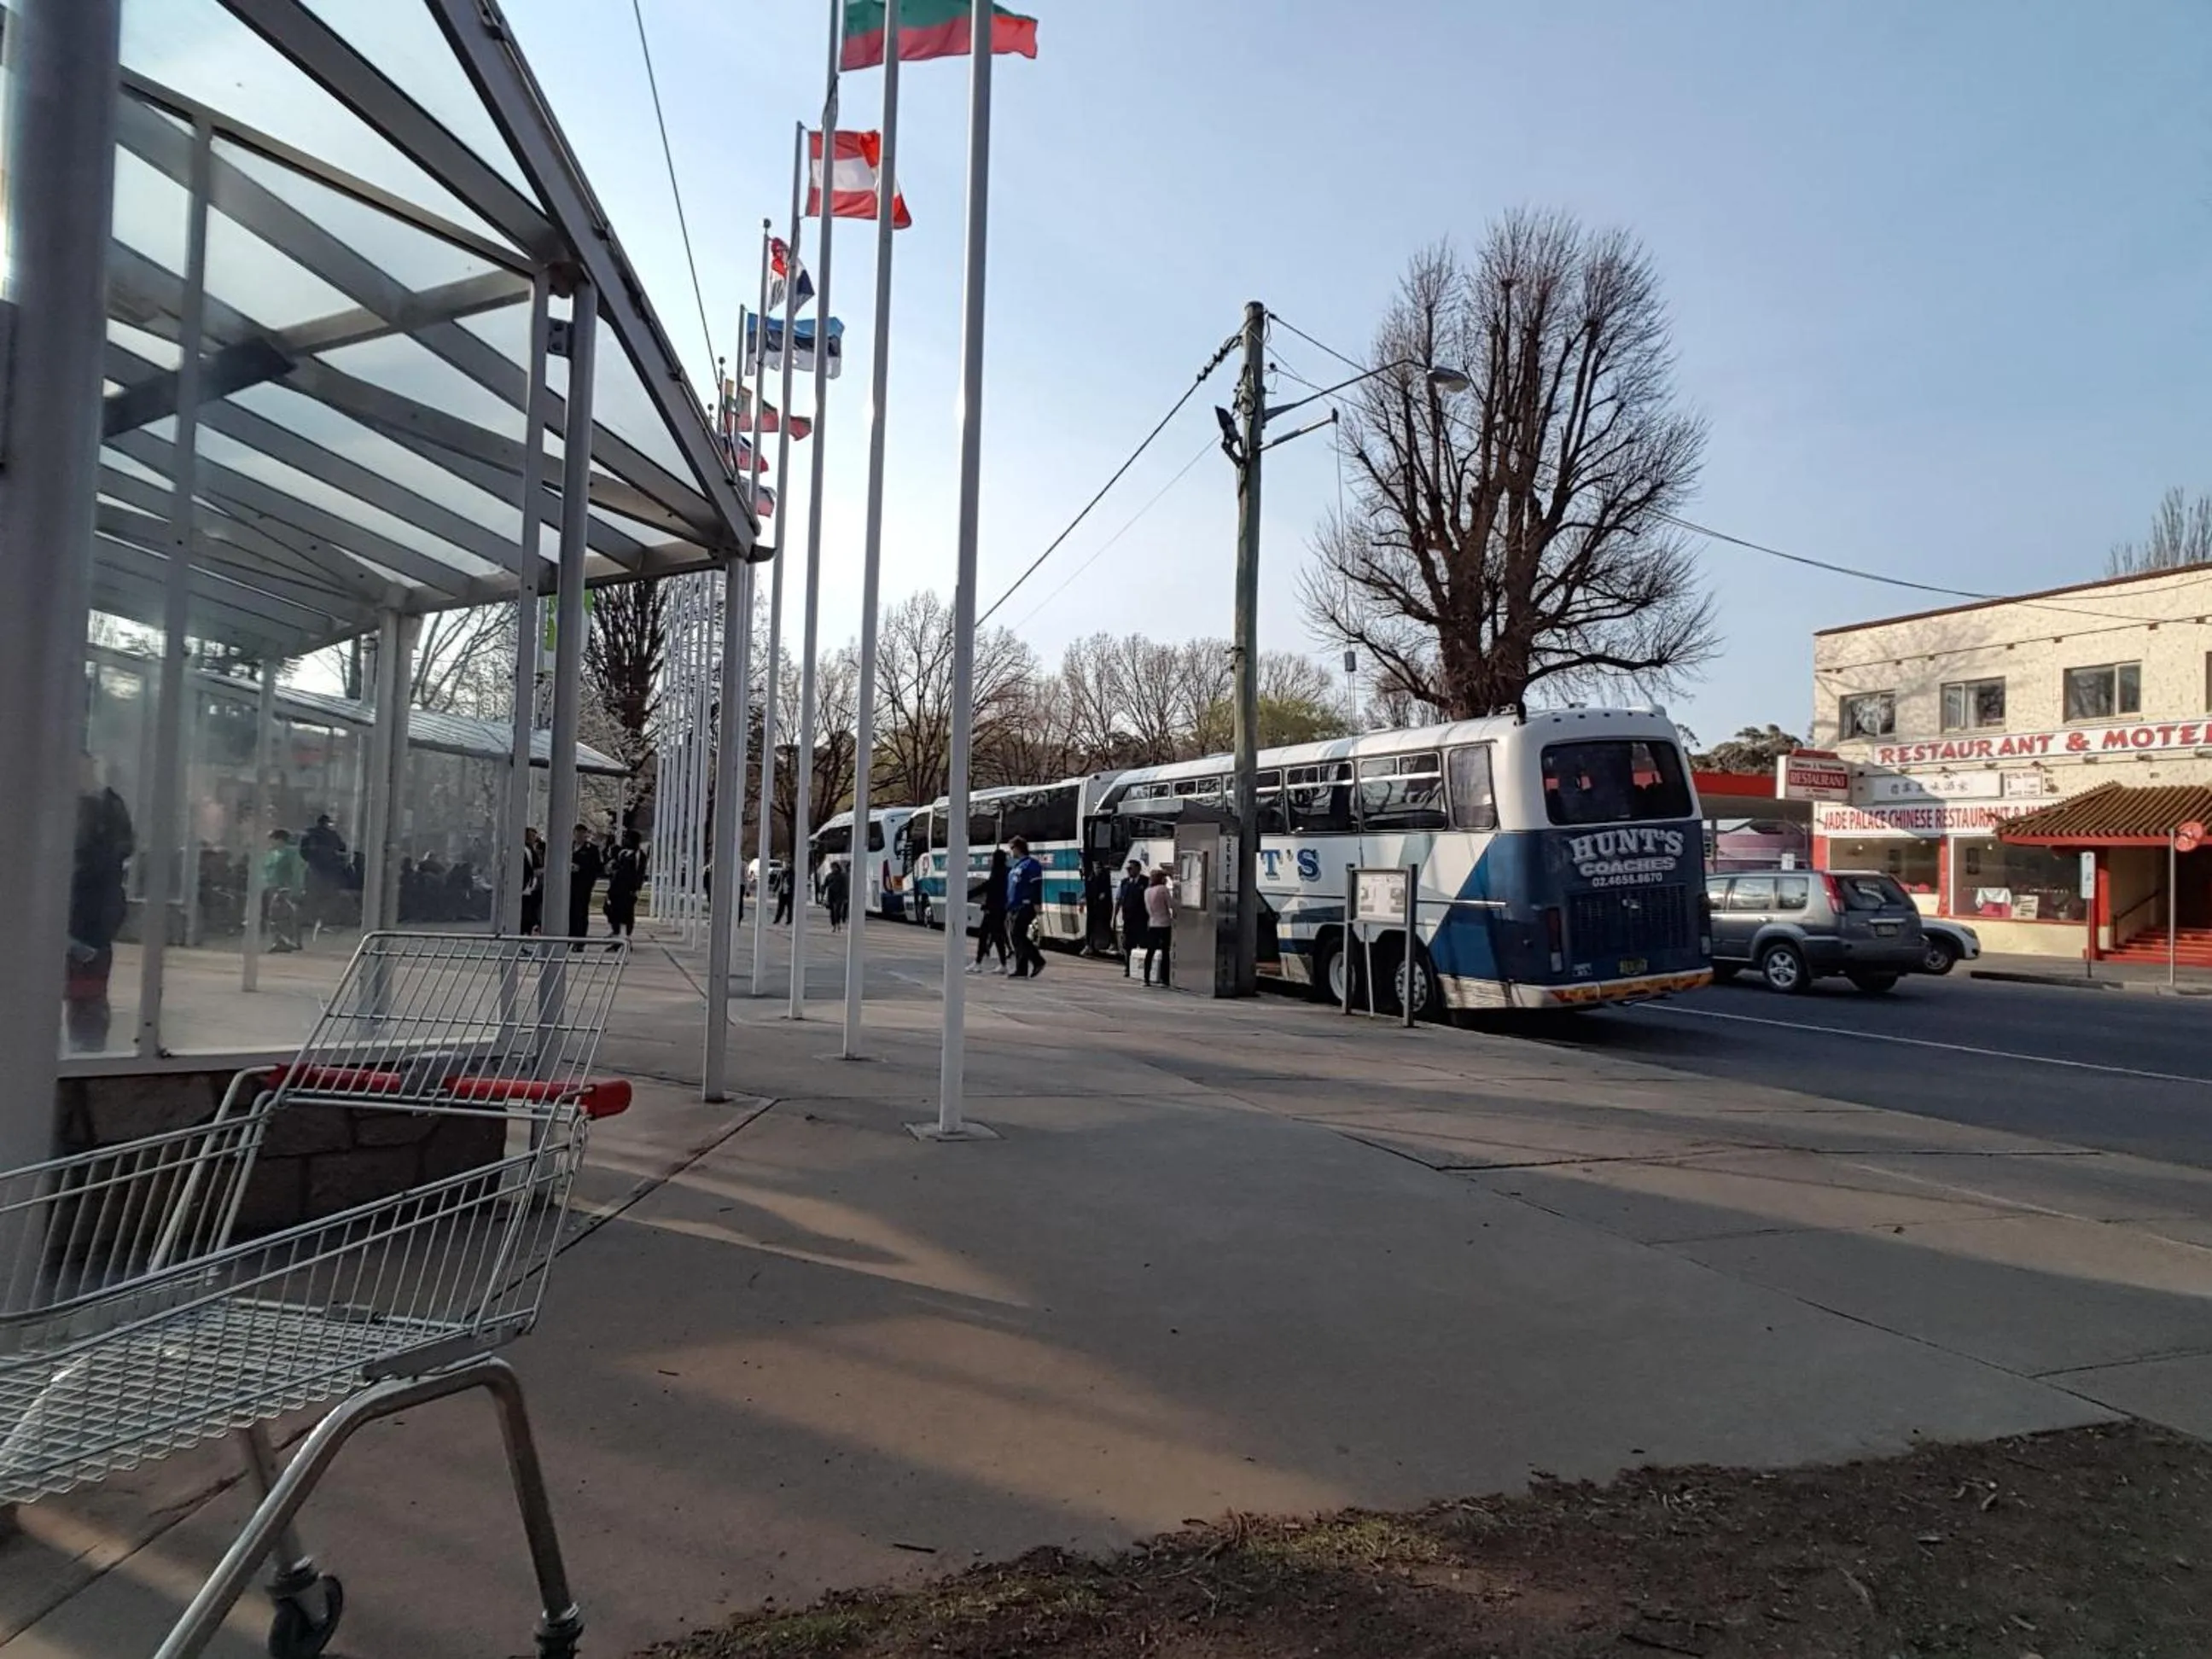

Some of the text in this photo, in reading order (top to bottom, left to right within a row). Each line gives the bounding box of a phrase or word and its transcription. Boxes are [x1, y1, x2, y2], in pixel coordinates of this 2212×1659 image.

[1880, 734, 2055, 765] RESTAURANT
[2065, 731, 2091, 752] &
[1790, 771, 1845, 787] RESTAURANT
[1824, 811, 1847, 830] JADE
[1849, 809, 1887, 830] PALACE
[1889, 807, 1933, 830] CHINESE
[1569, 828, 1685, 864] HUNT'S
[1260, 848, 1322, 882] T'S
[1580, 856, 1676, 877] COACHES
